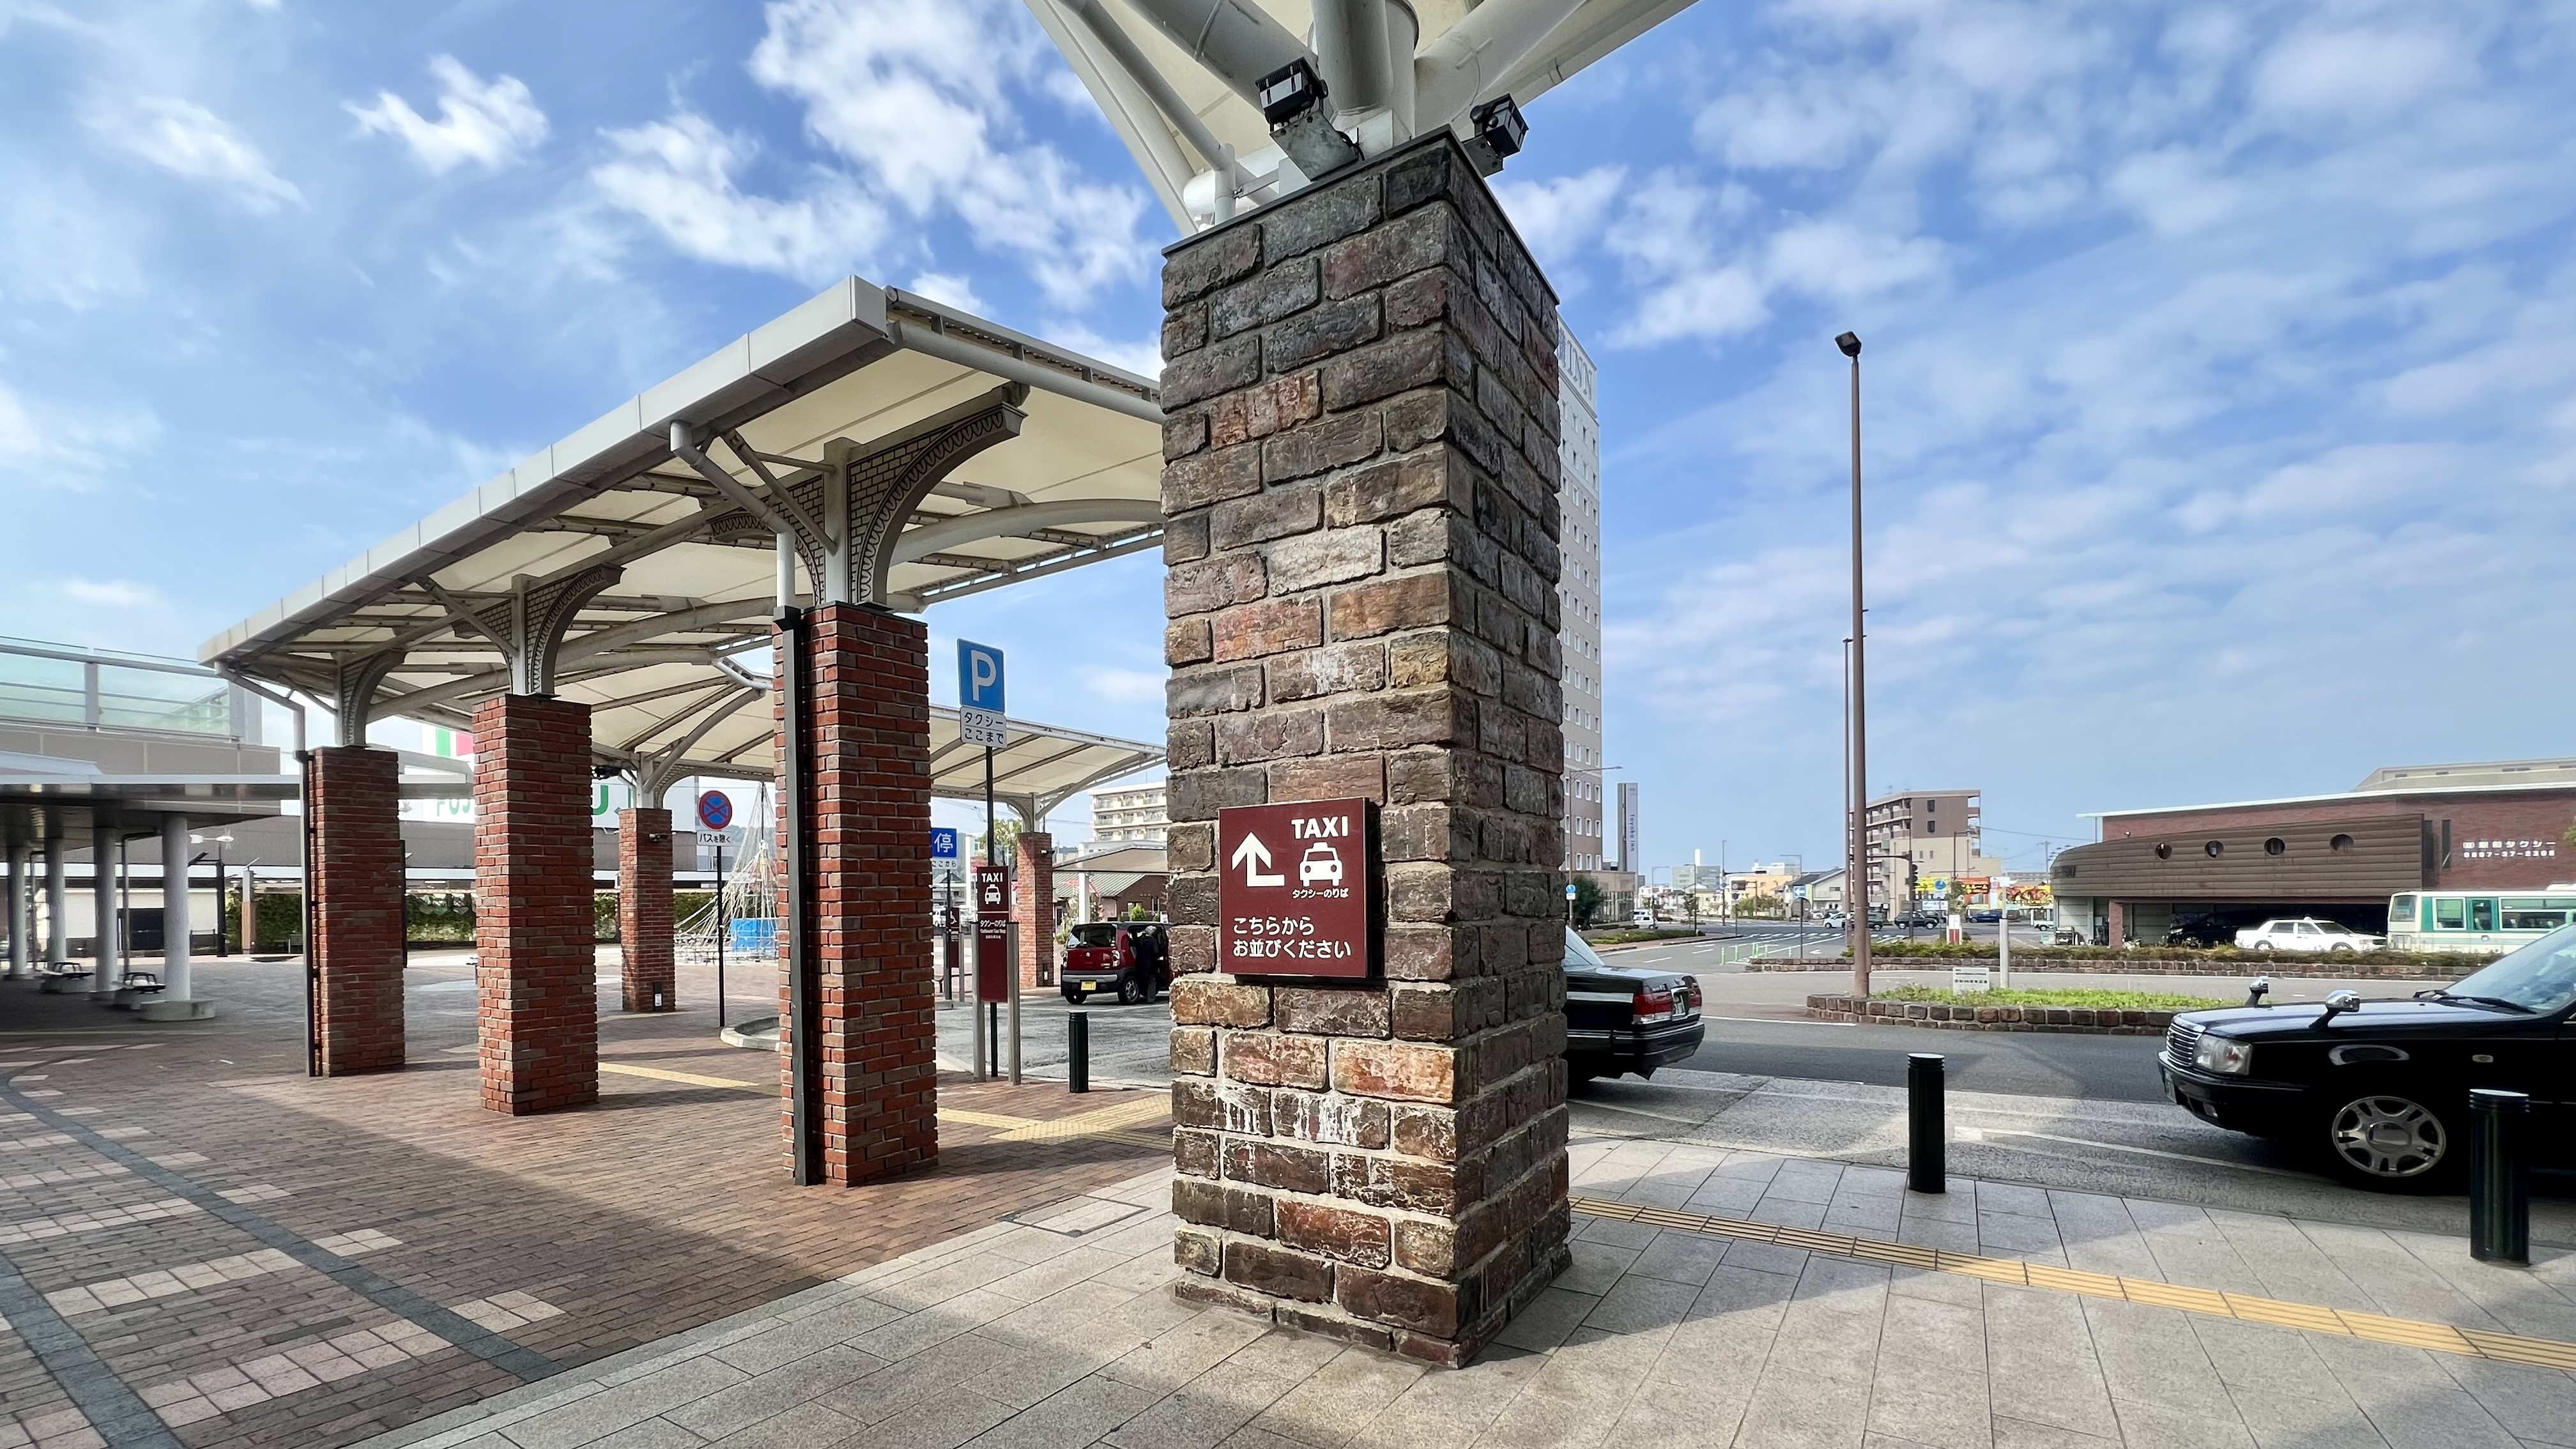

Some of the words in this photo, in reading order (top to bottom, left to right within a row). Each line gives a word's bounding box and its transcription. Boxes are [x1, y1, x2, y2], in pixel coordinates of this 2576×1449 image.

[970, 650, 997, 702] P
[964, 712, 1004, 728] タクシー
[965, 728, 1004, 744] ここまで
[1291, 816, 1349, 839] TAXI
[700, 833, 731, 843] バスを除く
[934, 832, 954, 854] 停
[981, 872, 1003, 883] TAXI
[1292, 887, 1349, 899] タクシーのりば
[1233, 916, 1315, 936] こちらから
[1232, 939, 1352, 959] お並びください
